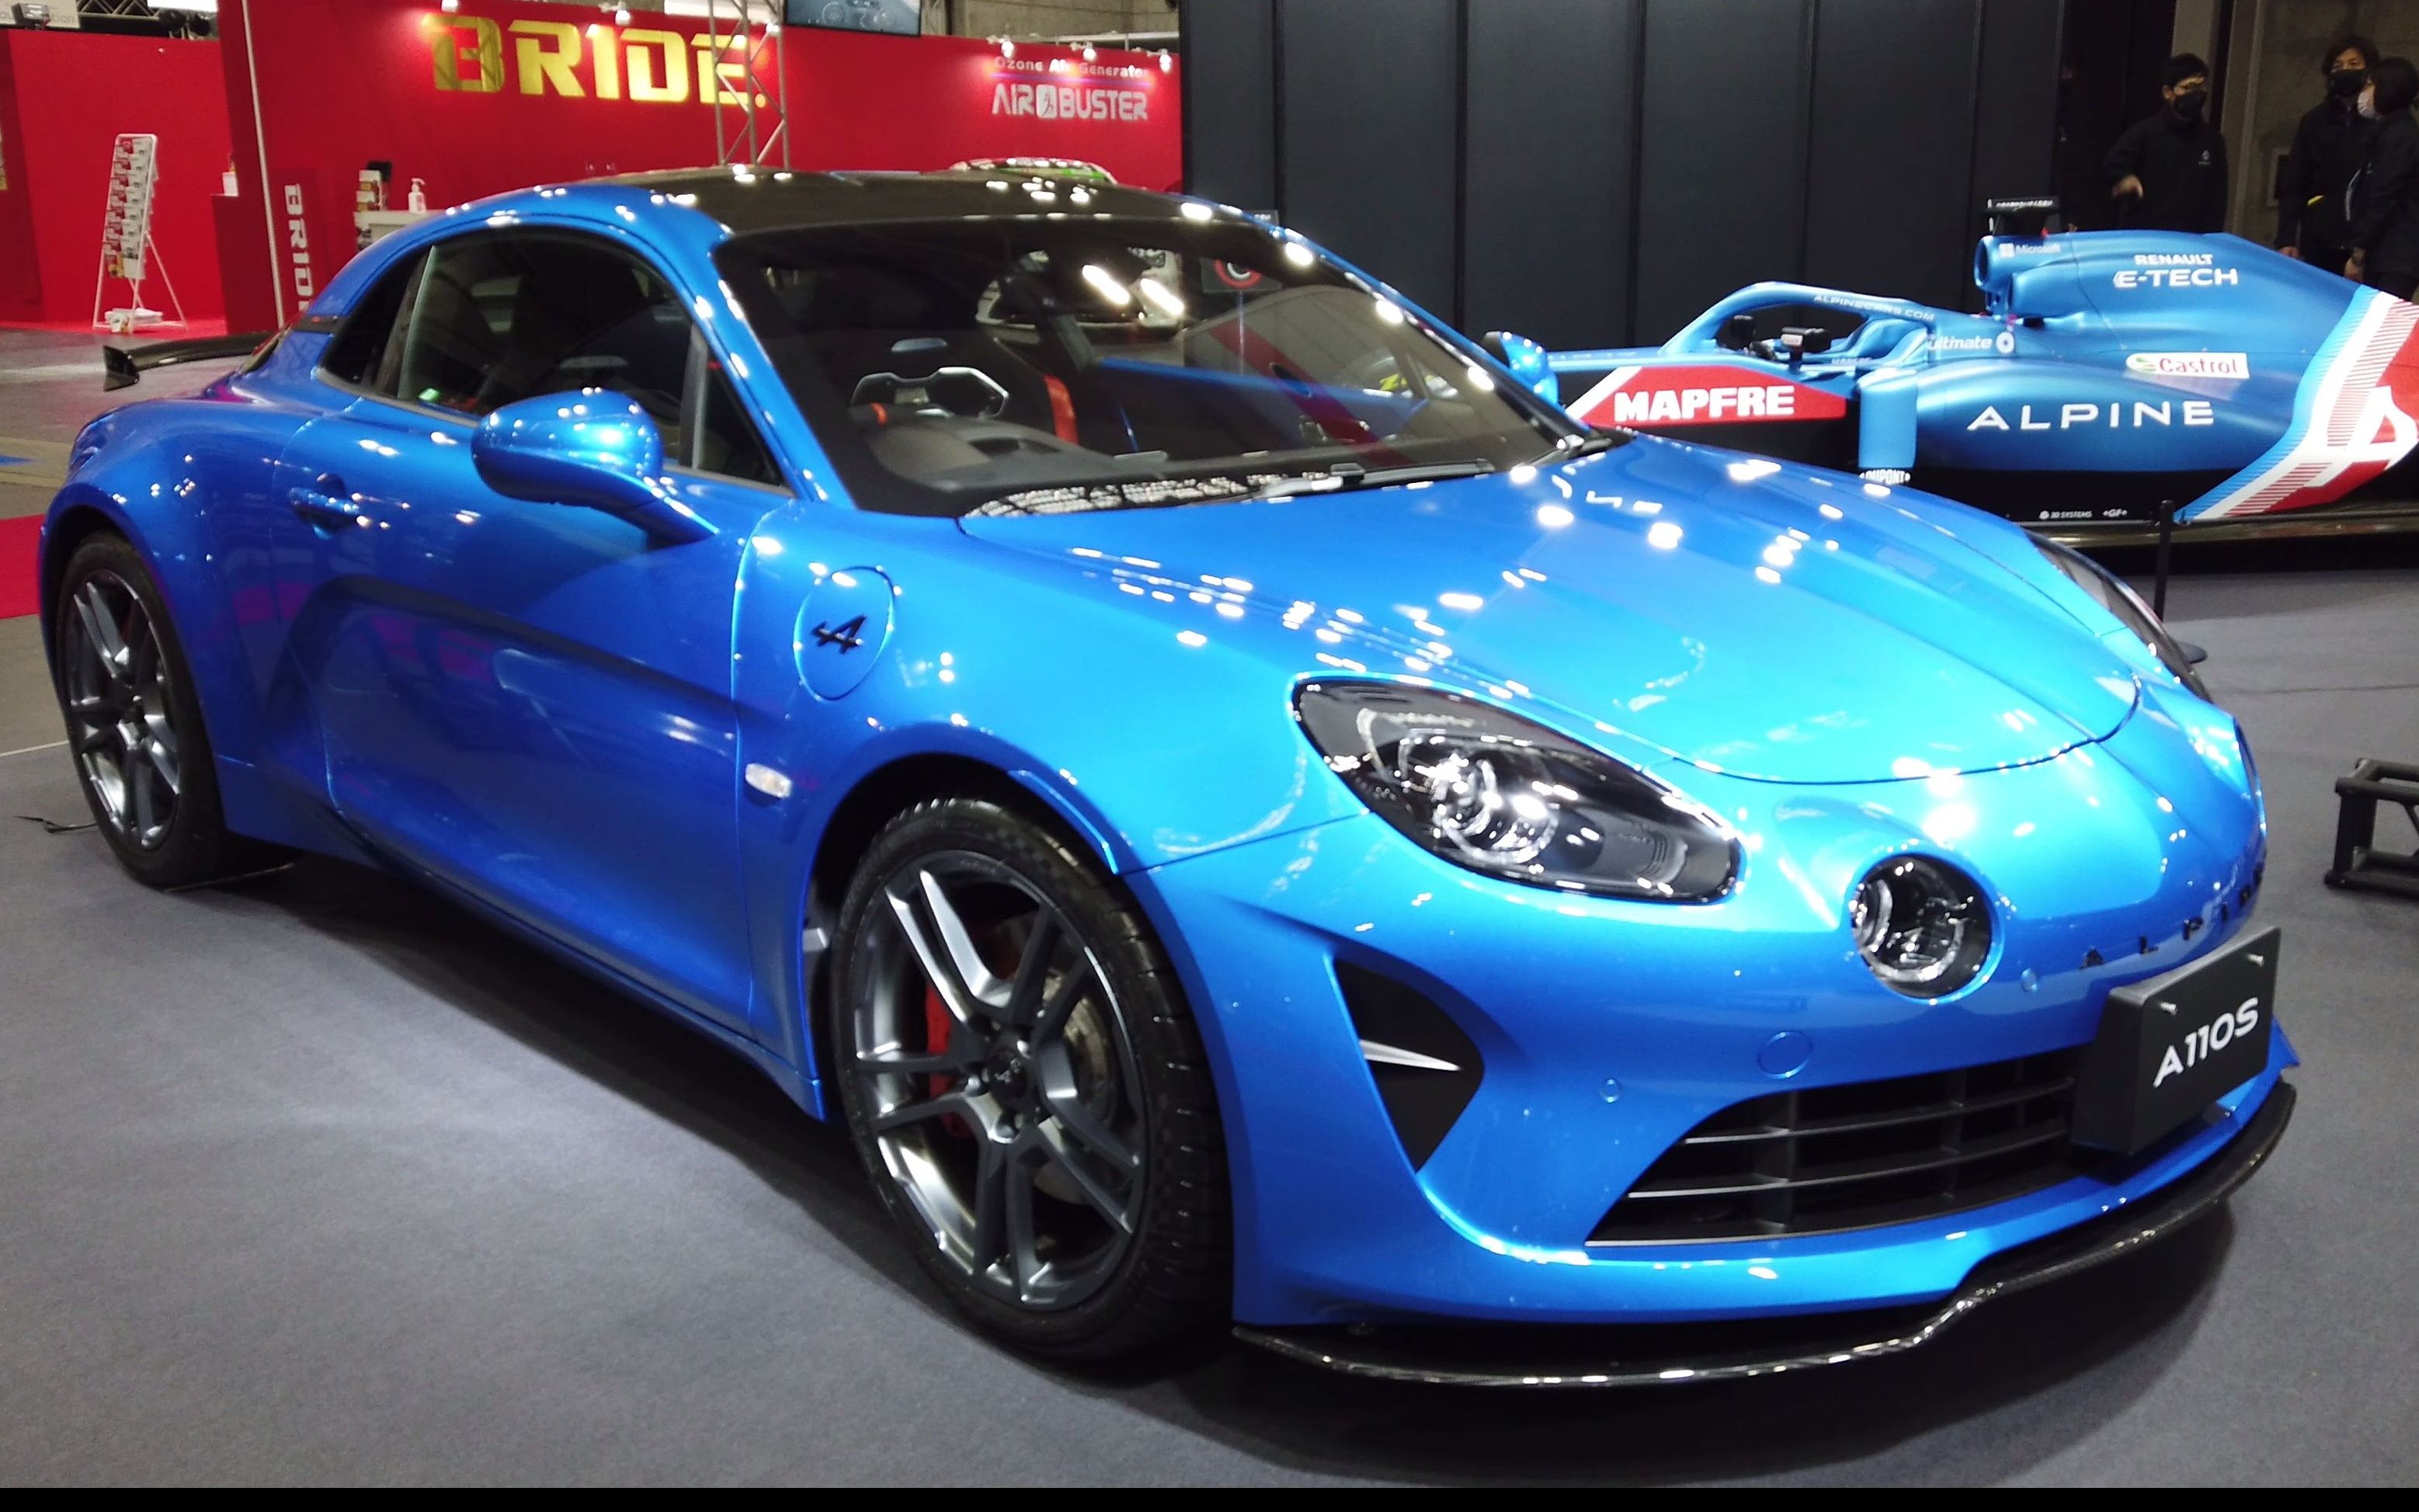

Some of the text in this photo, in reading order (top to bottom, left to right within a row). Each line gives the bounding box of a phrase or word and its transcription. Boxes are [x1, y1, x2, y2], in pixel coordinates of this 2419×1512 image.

[994, 56, 1044, 71] Ozone
[1058, 87, 1148, 121] BUSTER
[2134, 253, 2213, 266] RENAULT
[2113, 268, 2239, 288] E-TECH
[2160, 358, 2238, 374] Castrol
[1614, 385, 1795, 422] MAPFRE
[1966, 401, 2214, 430] ALPINE
[1865, 469, 1906, 485] DUPONT
[2153, 996, 2259, 1088] A110S
